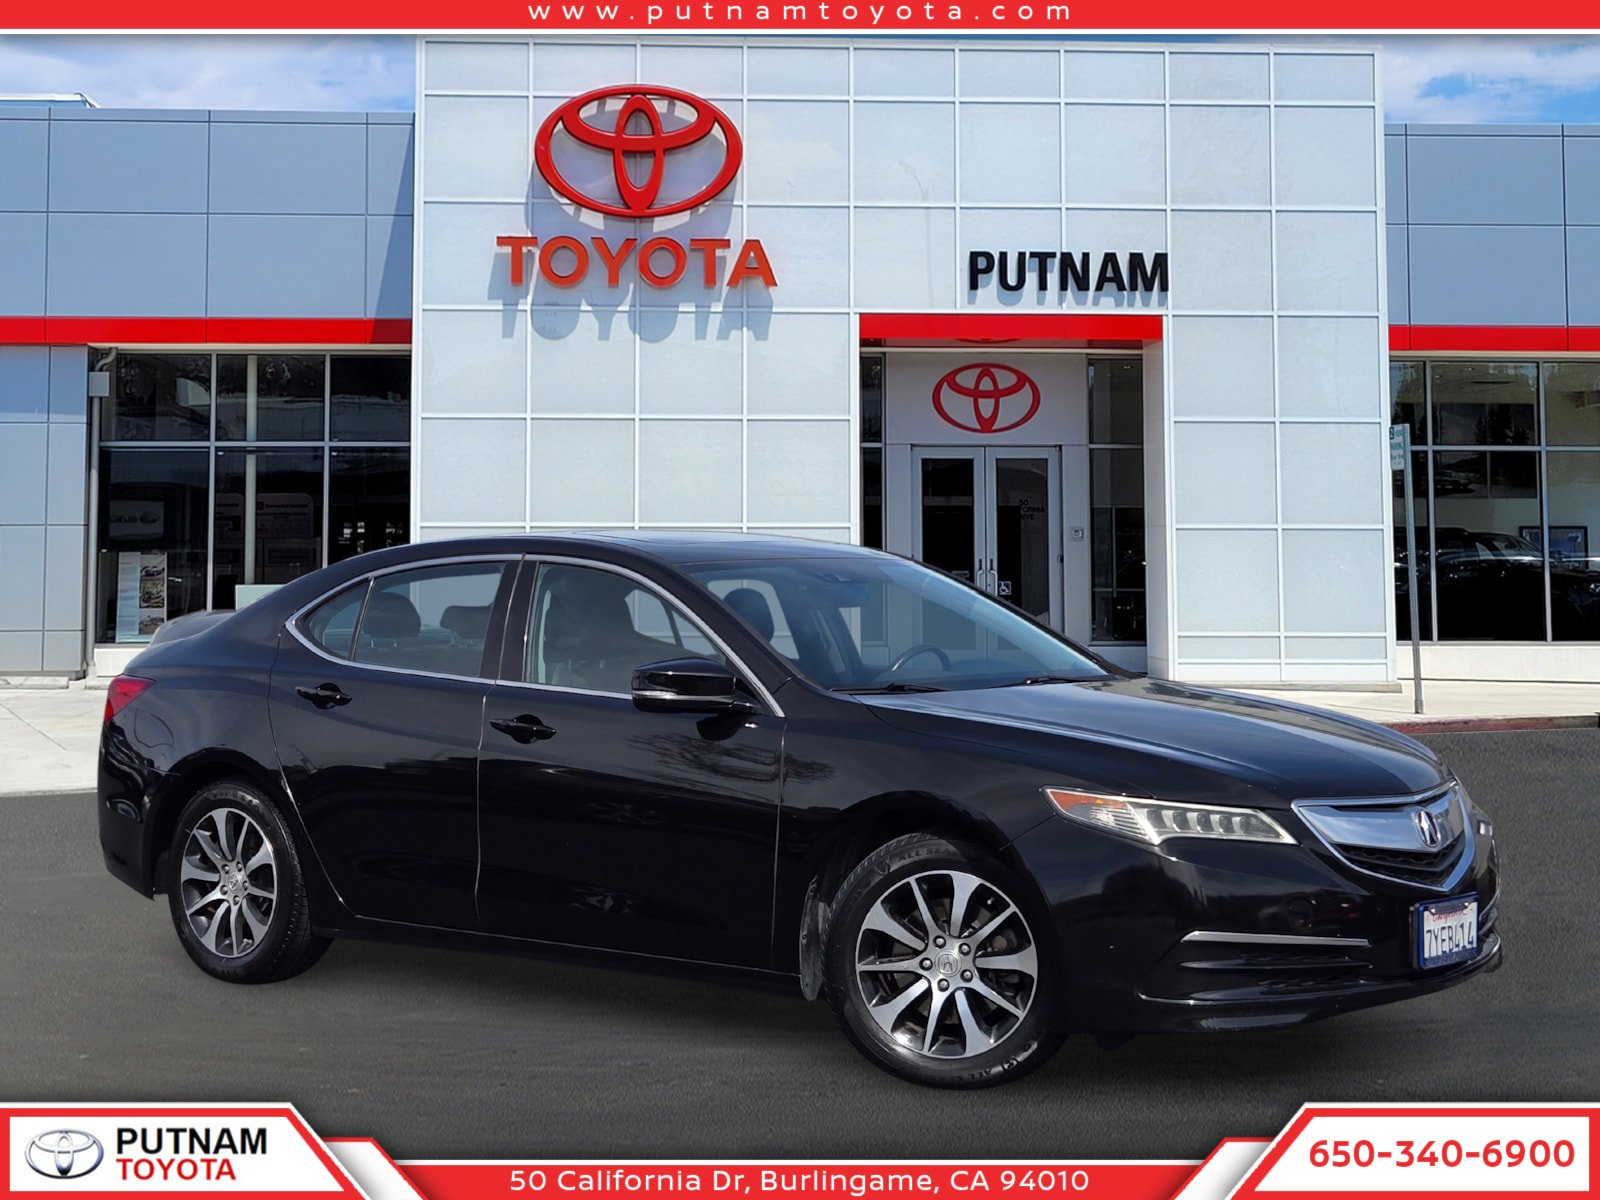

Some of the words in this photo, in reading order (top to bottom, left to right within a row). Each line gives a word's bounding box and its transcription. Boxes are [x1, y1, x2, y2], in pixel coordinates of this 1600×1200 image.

[496, 236, 777, 288] TOYOTA
[969, 251, 1169, 292] PUTNAM
[1425, 921, 1475, 957] 7YEB414
